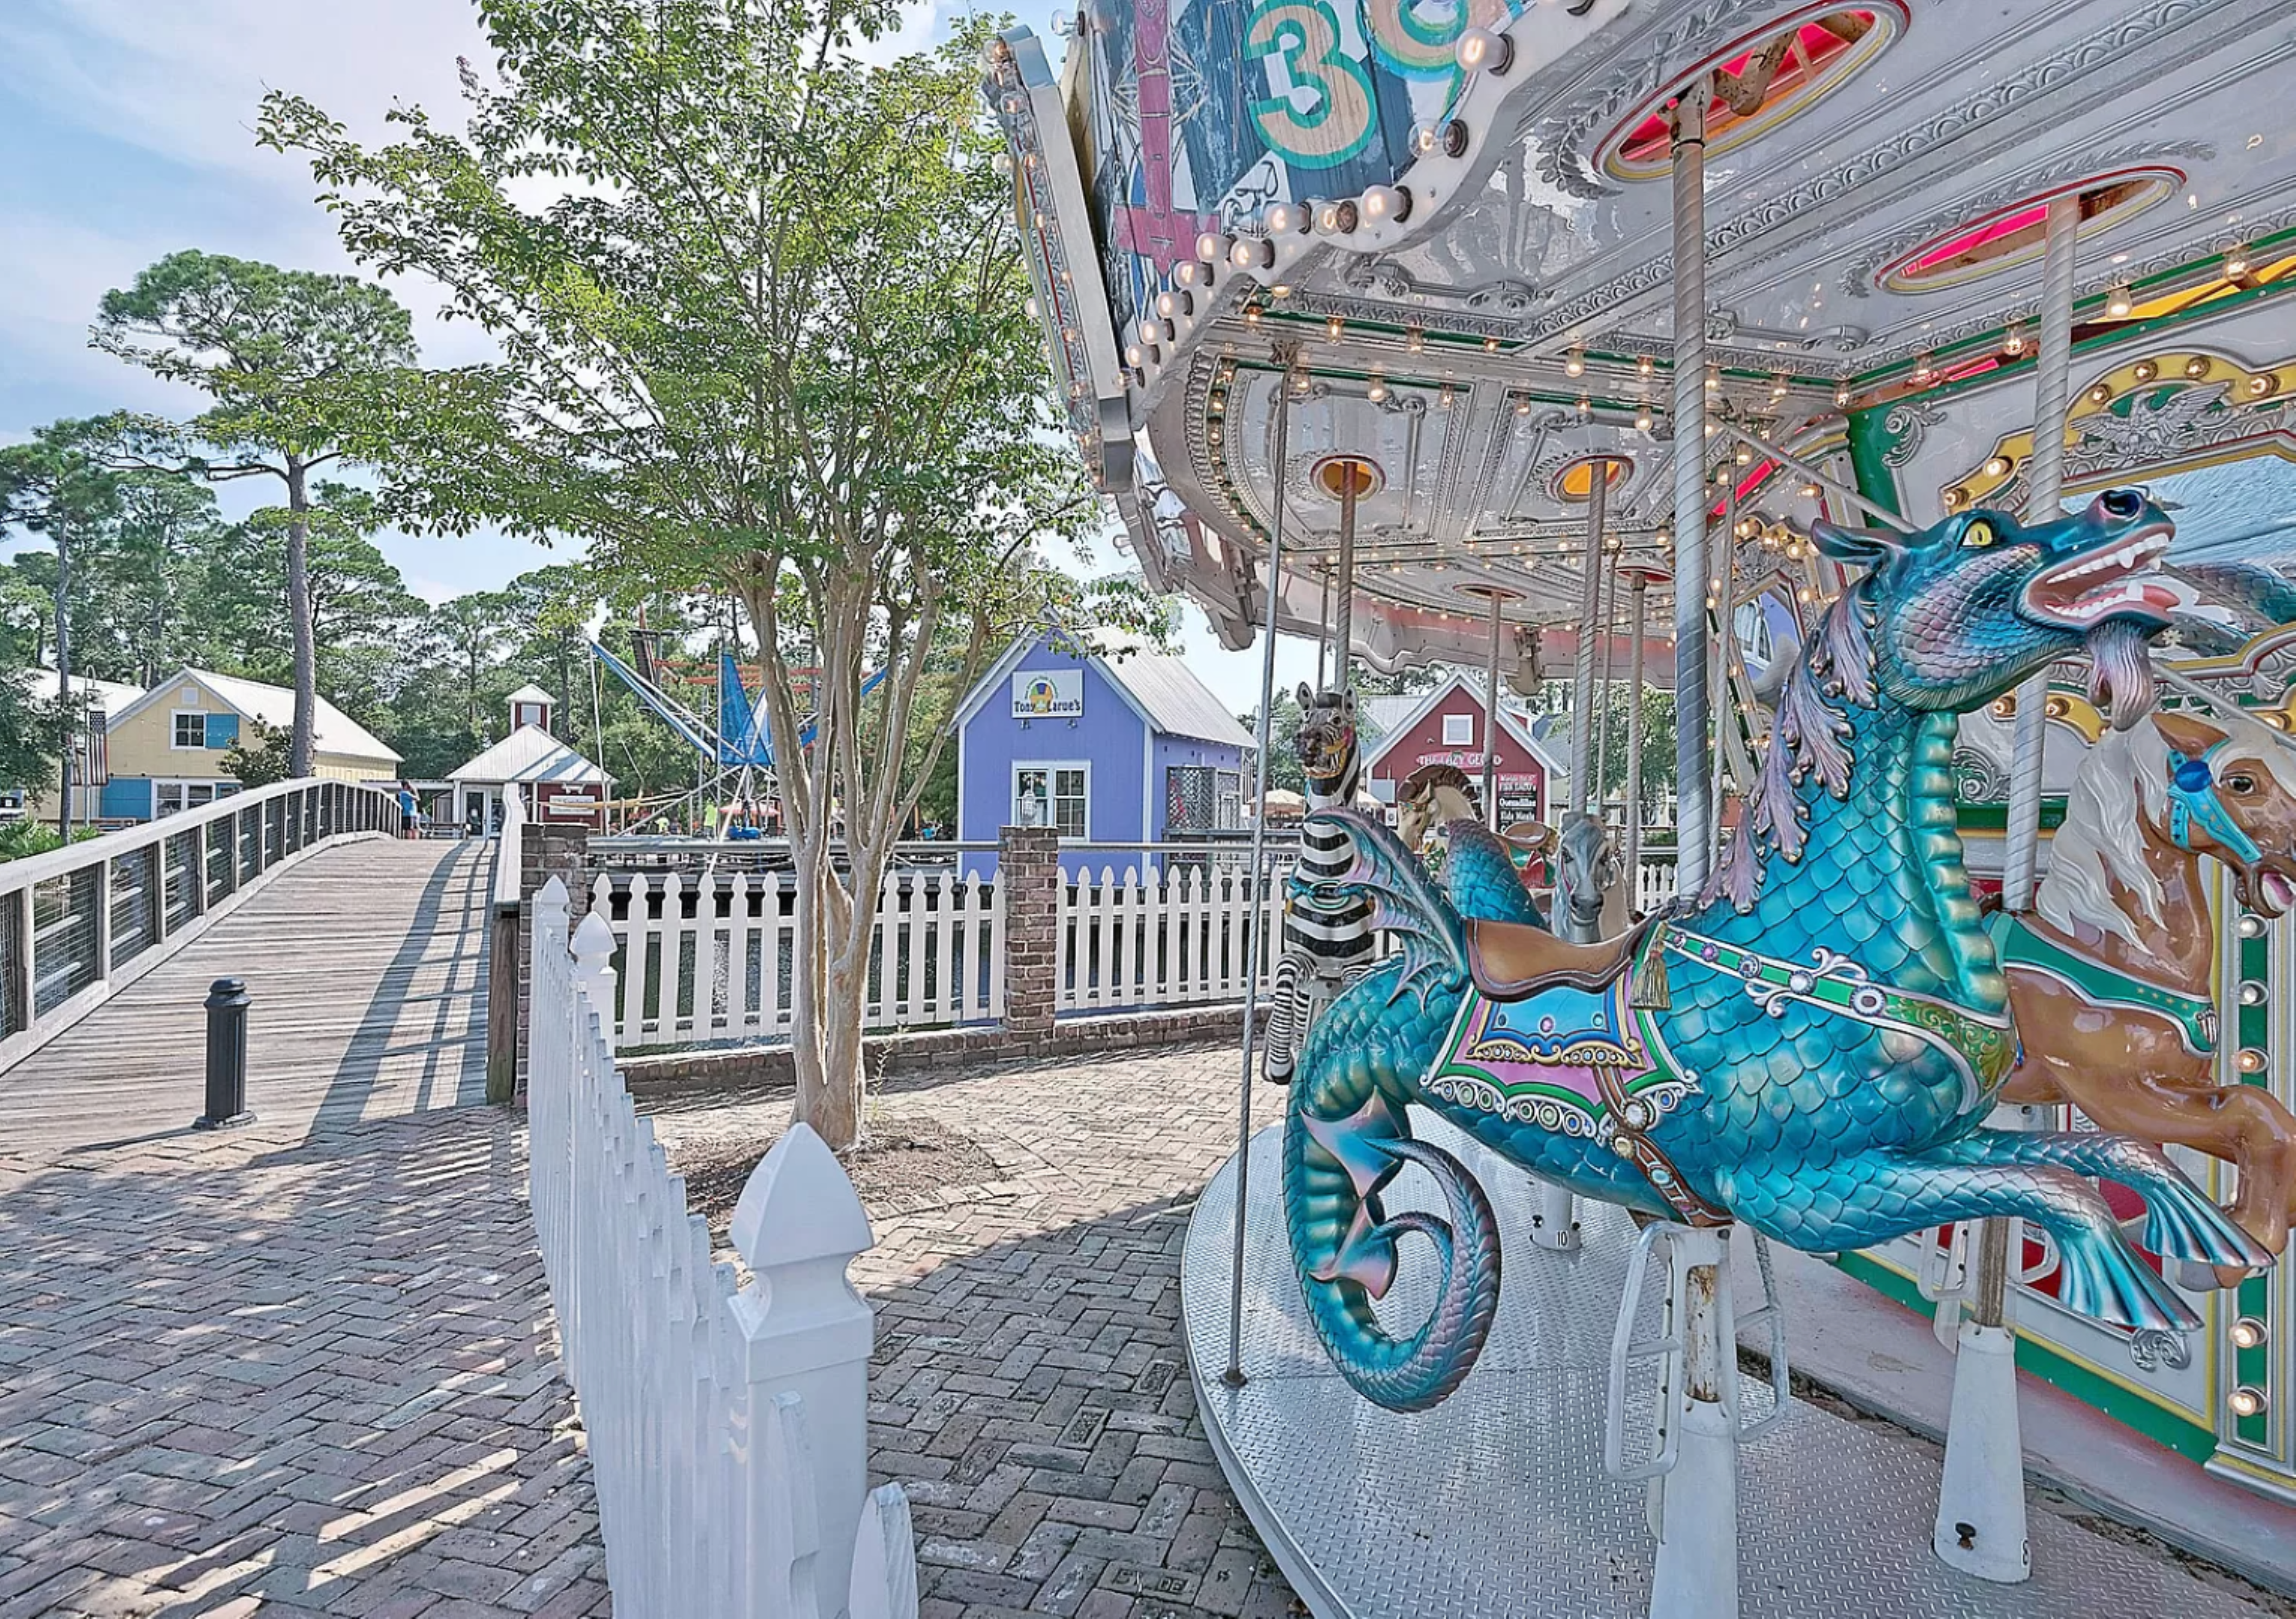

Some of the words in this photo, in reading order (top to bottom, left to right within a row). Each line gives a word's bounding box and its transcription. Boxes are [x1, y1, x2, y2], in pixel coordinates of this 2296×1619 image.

[1014, 701, 1036, 712] Tony
[1468, 753, 1502, 765] GECO
[1557, 1231, 1568, 1247] 10
